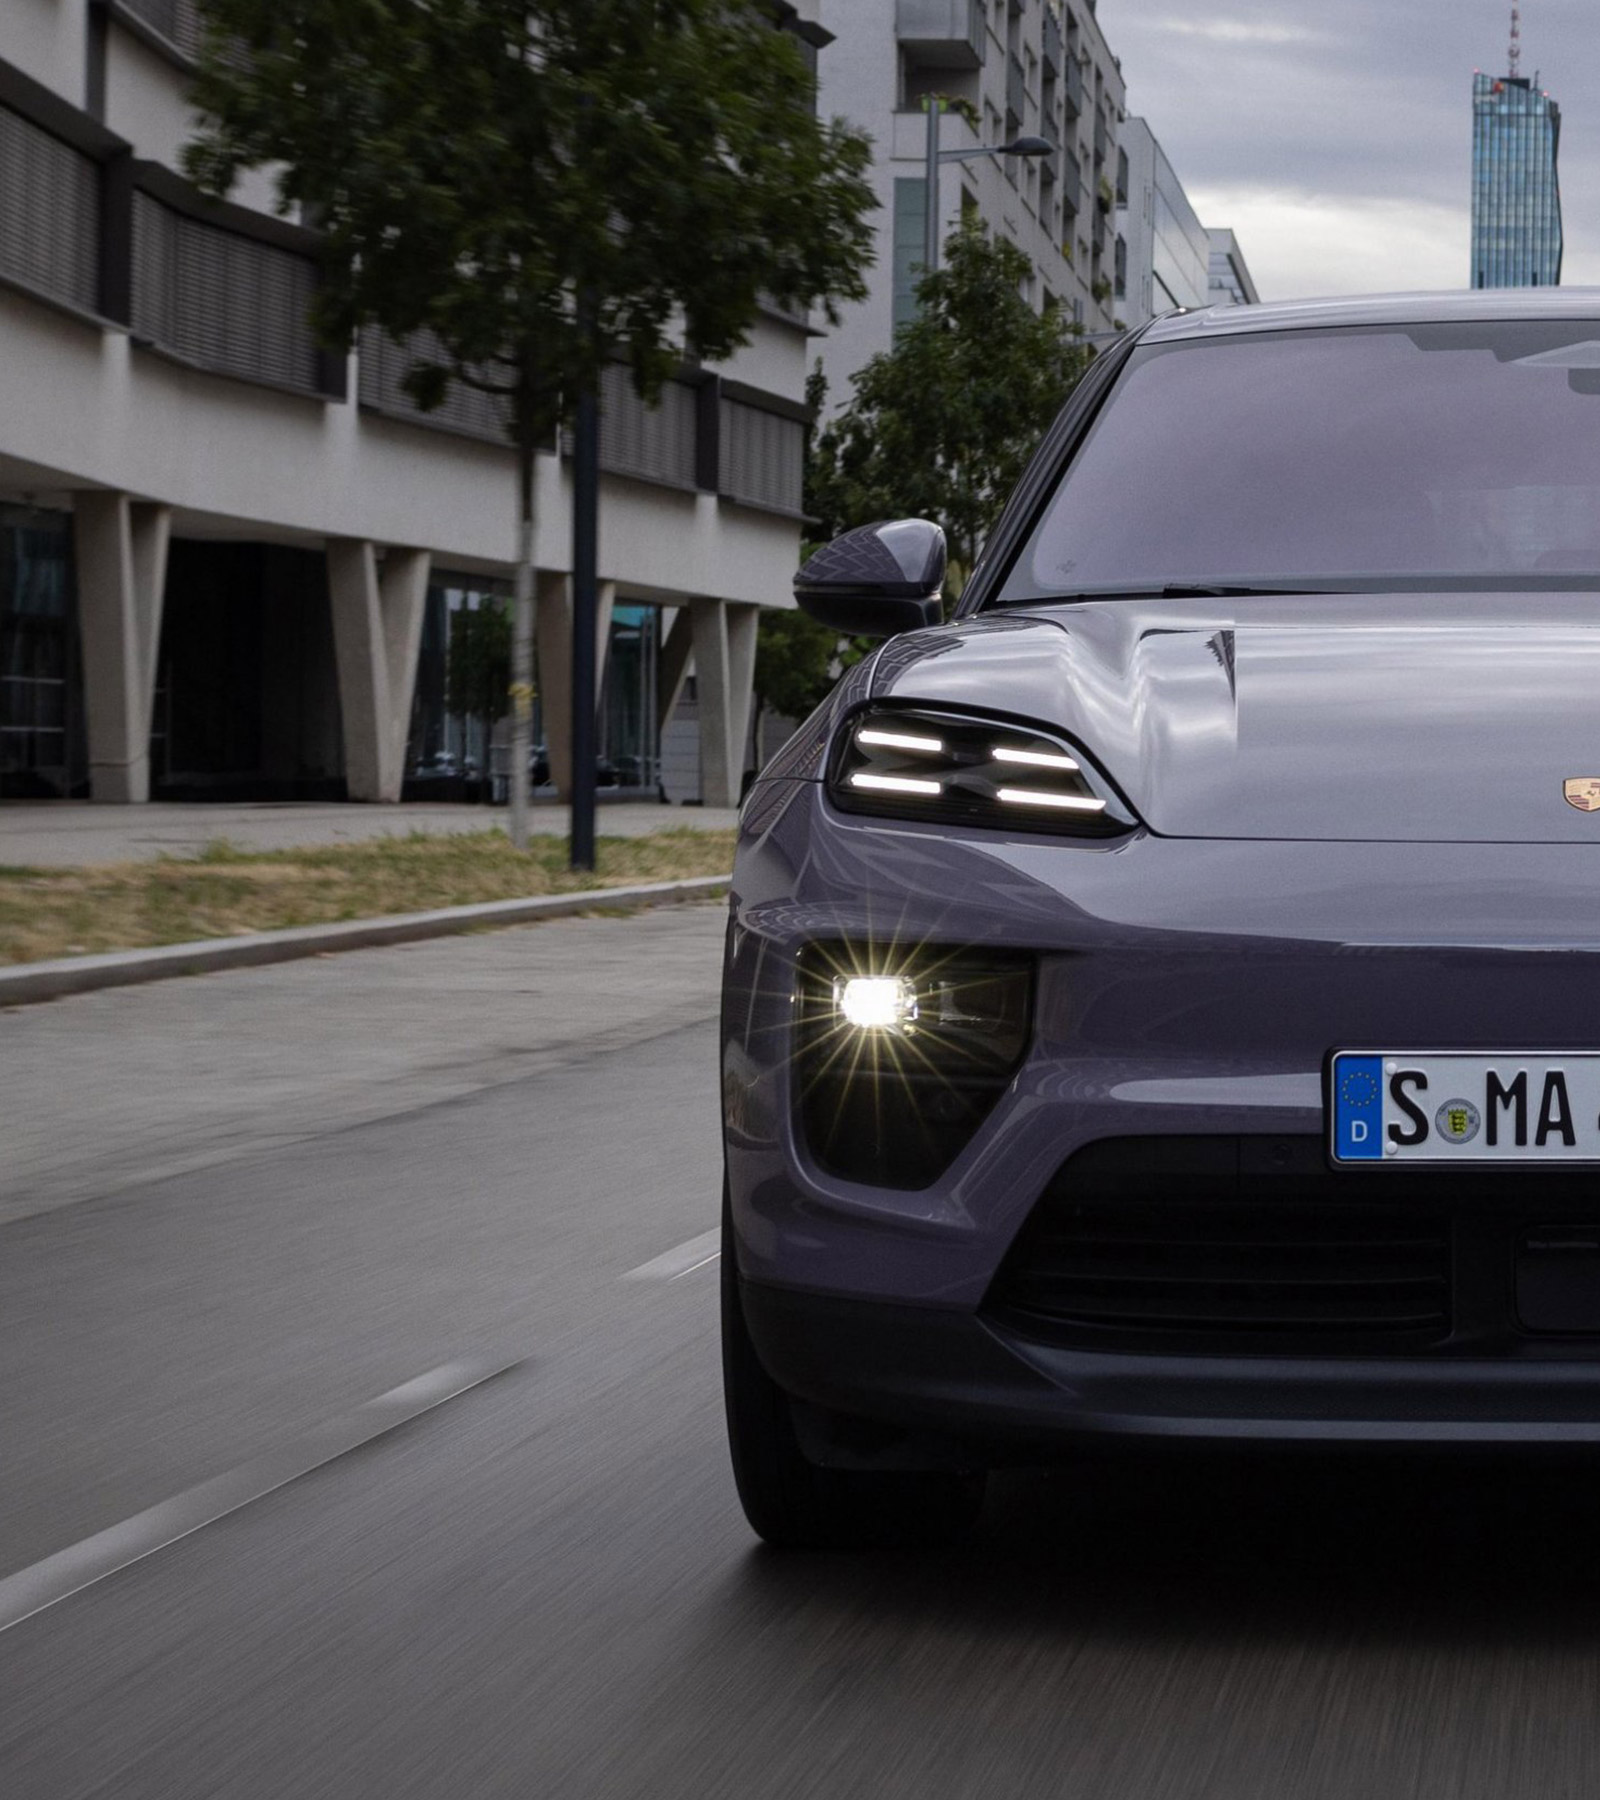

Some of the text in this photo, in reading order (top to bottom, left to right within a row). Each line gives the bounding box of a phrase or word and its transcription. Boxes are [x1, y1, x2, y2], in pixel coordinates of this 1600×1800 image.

[1351, 1120, 1368, 1142] D
[1388, 1070, 1429, 1146] S
[1486, 1071, 1576, 1146] MA
